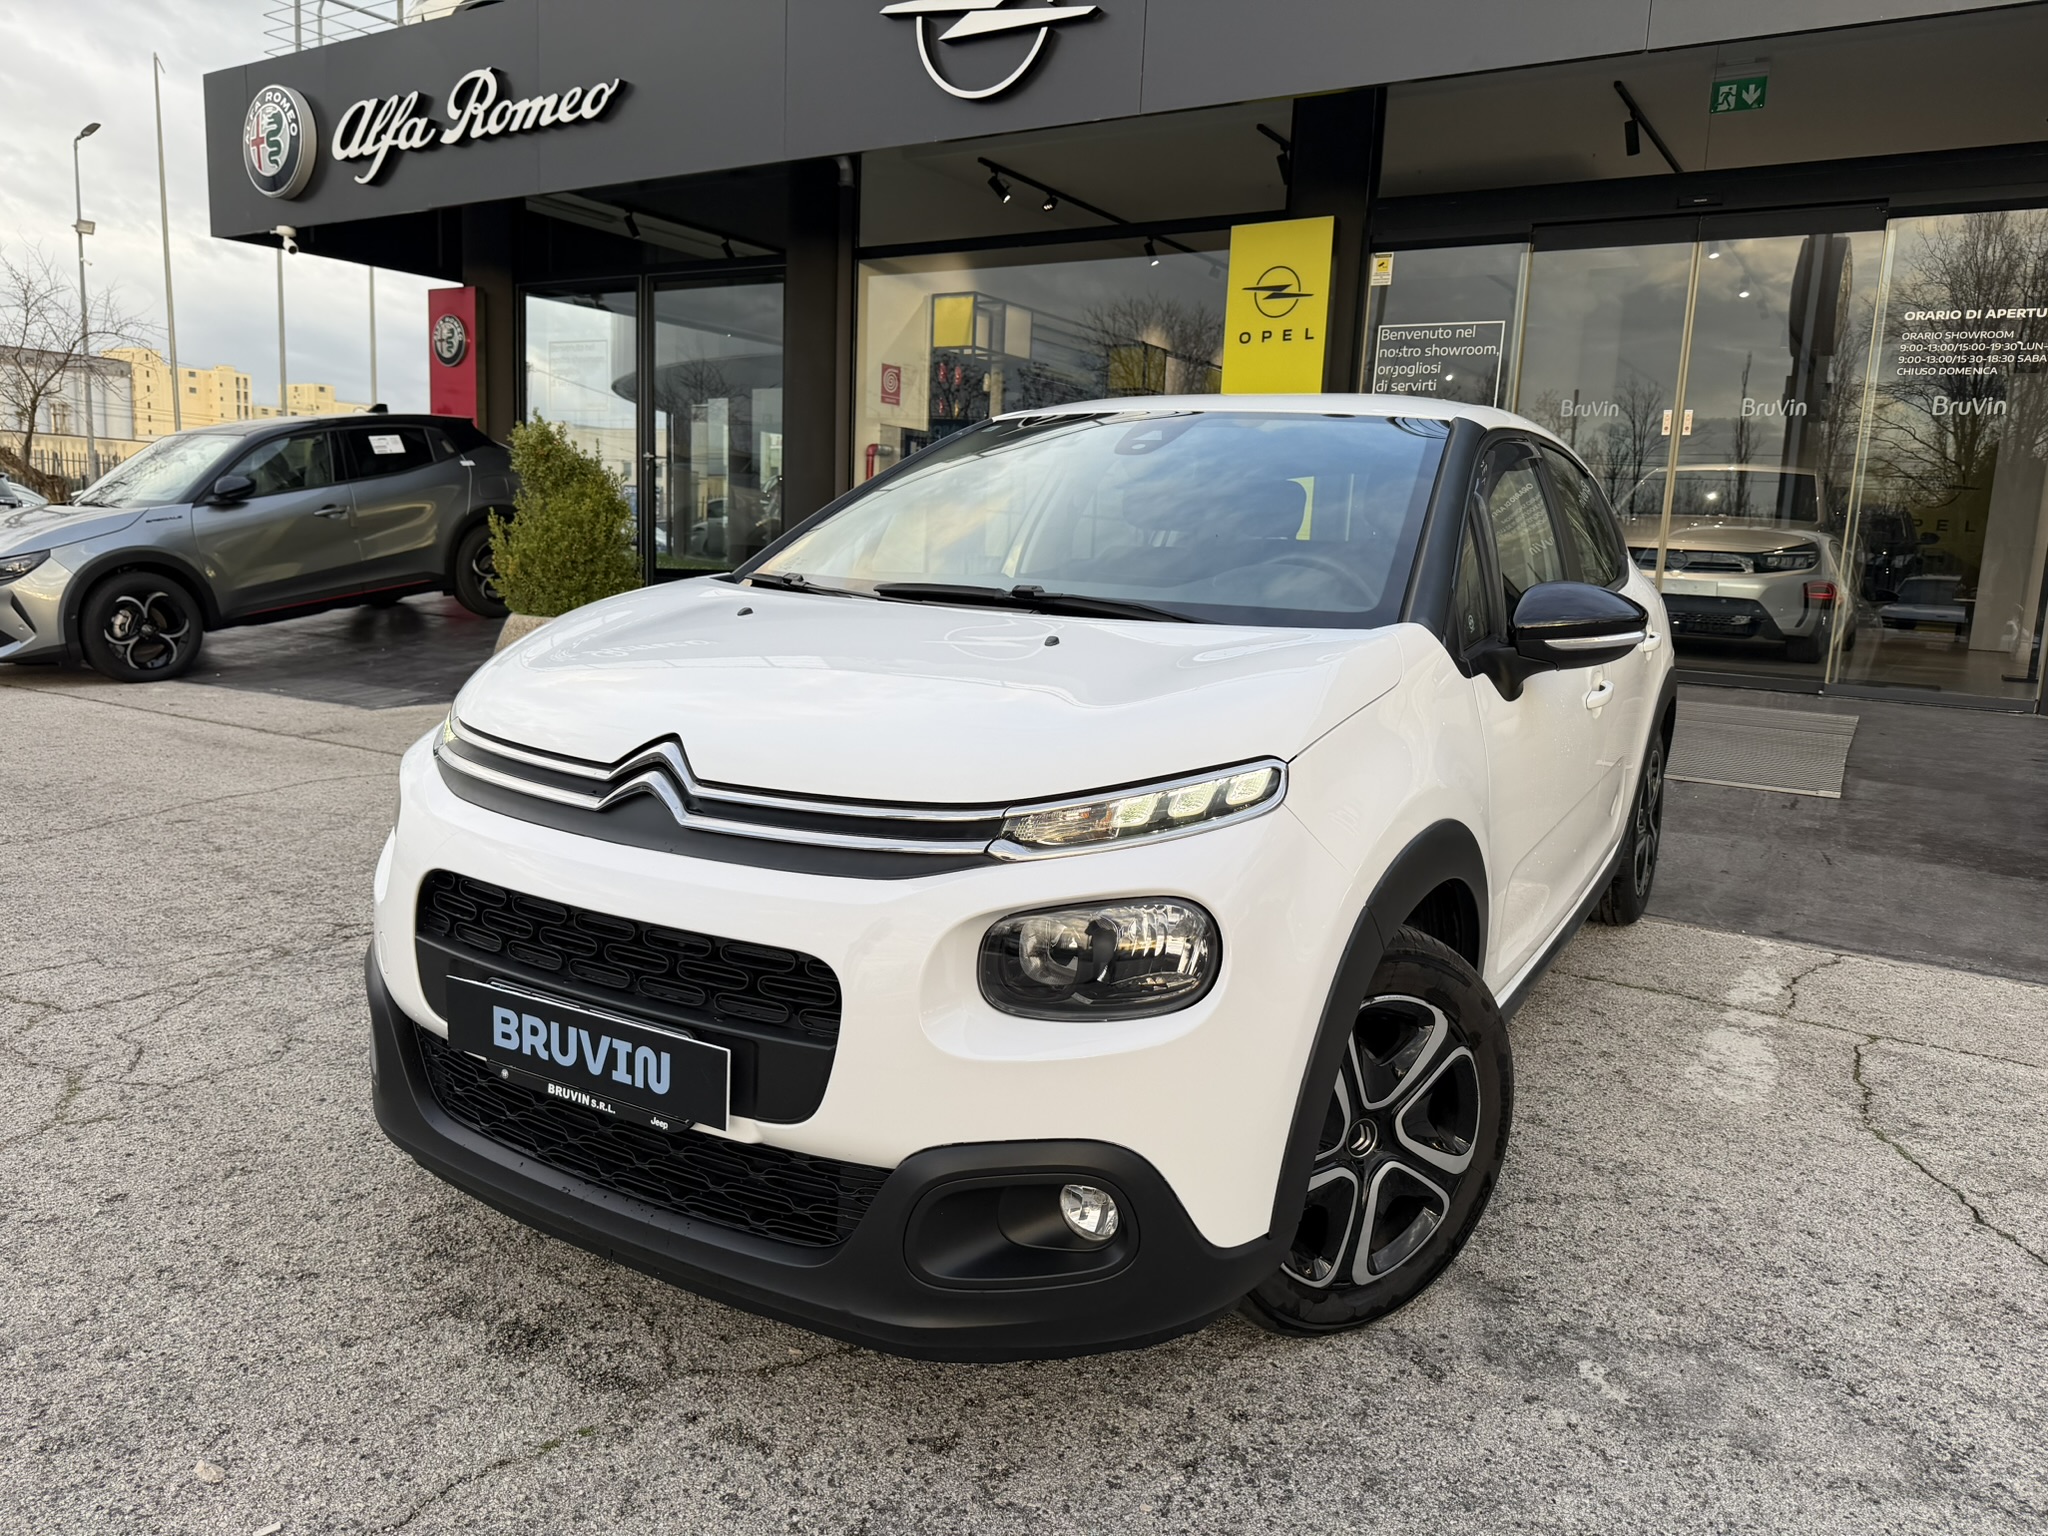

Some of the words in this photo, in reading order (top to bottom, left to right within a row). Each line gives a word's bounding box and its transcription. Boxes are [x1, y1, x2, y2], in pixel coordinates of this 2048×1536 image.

[245, 101, 261, 145] ALFA
[265, 91, 298, 137] ROMEO
[331, 90, 436, 185] Alfa
[440, 66, 620, 145] Romeo
[1904, 310, 1962, 321] ORARIO
[1965, 310, 1981, 319] DI
[1239, 328, 1314, 344] OPEL
[1381, 327, 1452, 341] Benvenuto
[1456, 325, 1476, 338] nel
[1901, 331, 1942, 340] ORARIO
[1945, 330, 2014, 340] SHOWROOM
[1379, 345, 1421, 358] nostro
[1424, 344, 1500, 357] showroom,
[1377, 362, 1441, 378] orgogliosi
[1897, 367, 1936, 375] CHIUSO
[1938, 366, 1998, 375] DOMENICA
[1376, 380, 1387, 392] di
[1391, 379, 1437, 392] servirti
[1561, 399, 1620, 417] BruVin
[1741, 398, 1807, 417] BruVin
[1932, 395, 2007, 416] BruVin
[492, 1004, 671, 1095] BRUVIN
[547, 1083, 591, 1106] BRUVIN
[650, 1116, 669, 1131] Jeep
